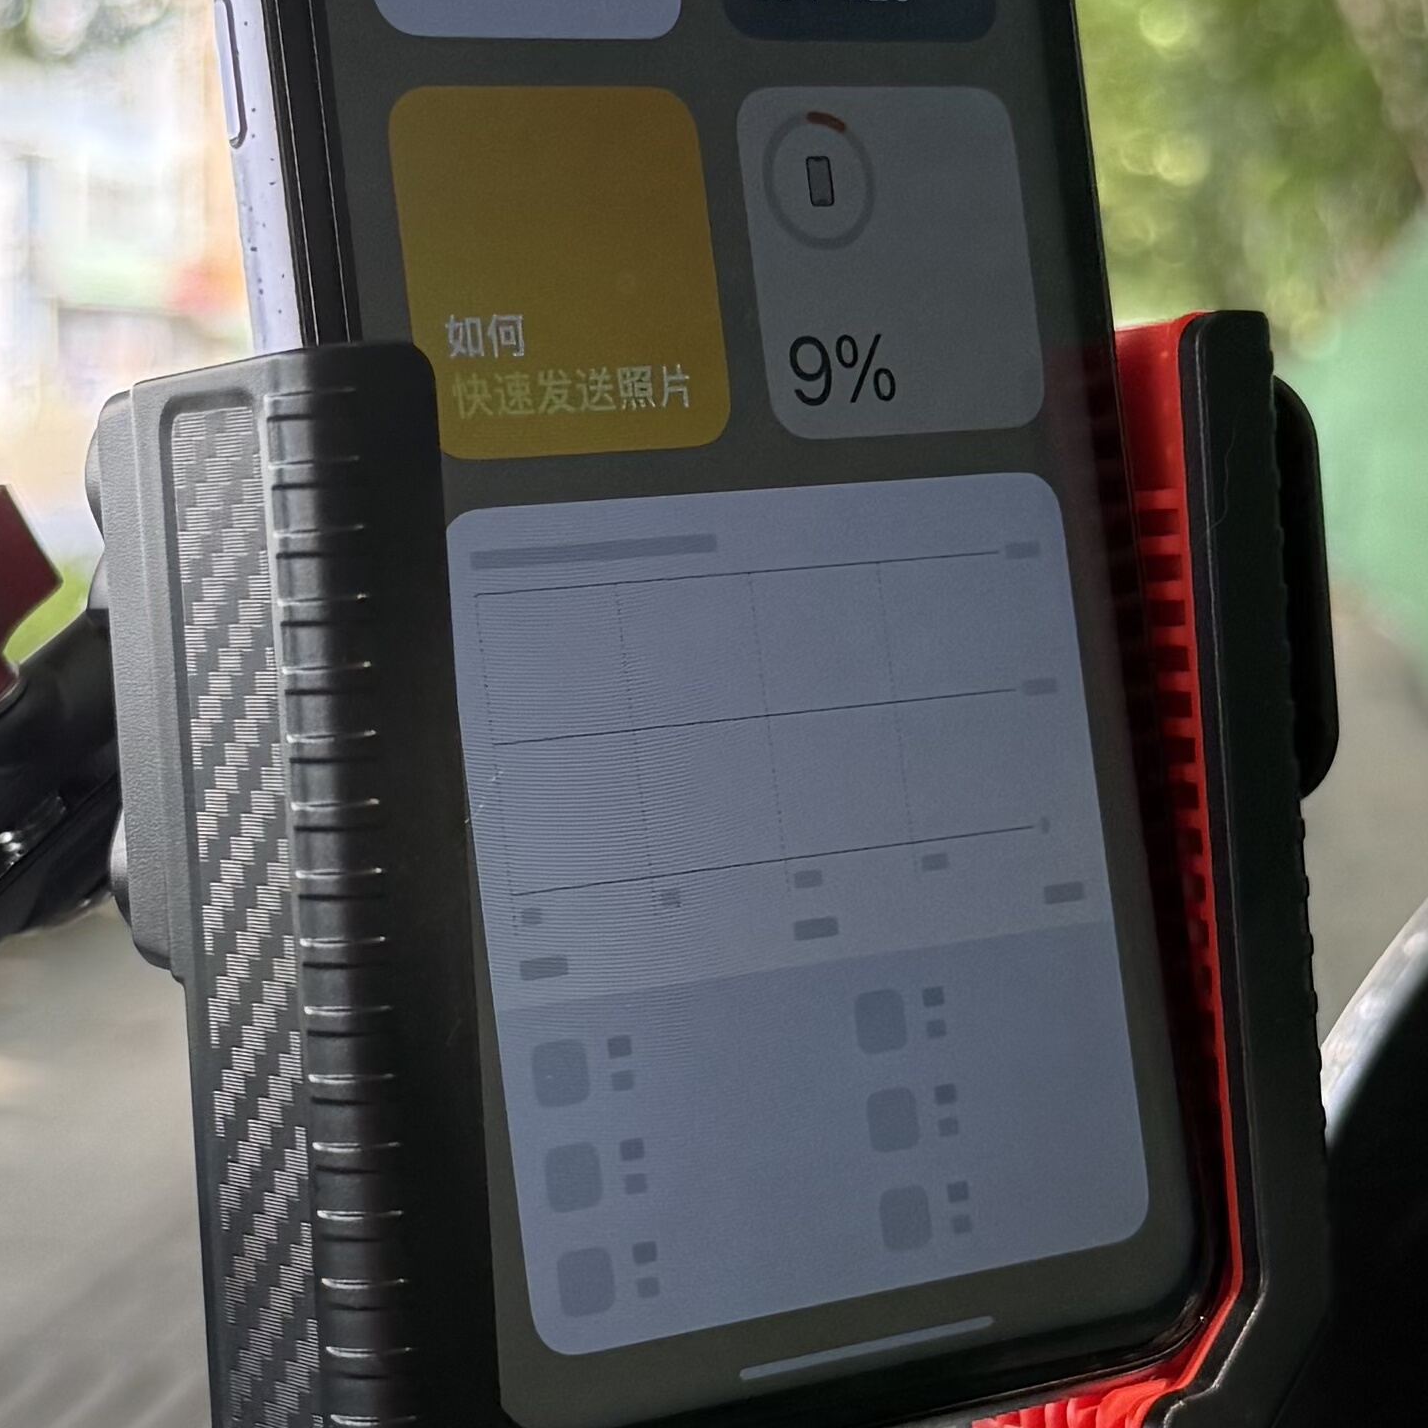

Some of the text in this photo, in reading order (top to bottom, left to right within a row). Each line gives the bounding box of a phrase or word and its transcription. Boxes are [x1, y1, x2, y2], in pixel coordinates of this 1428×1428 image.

[445, 313, 525, 358] 如何
[452, 363, 691, 420] 快速发送照片
[788, 333, 896, 407] 9%
